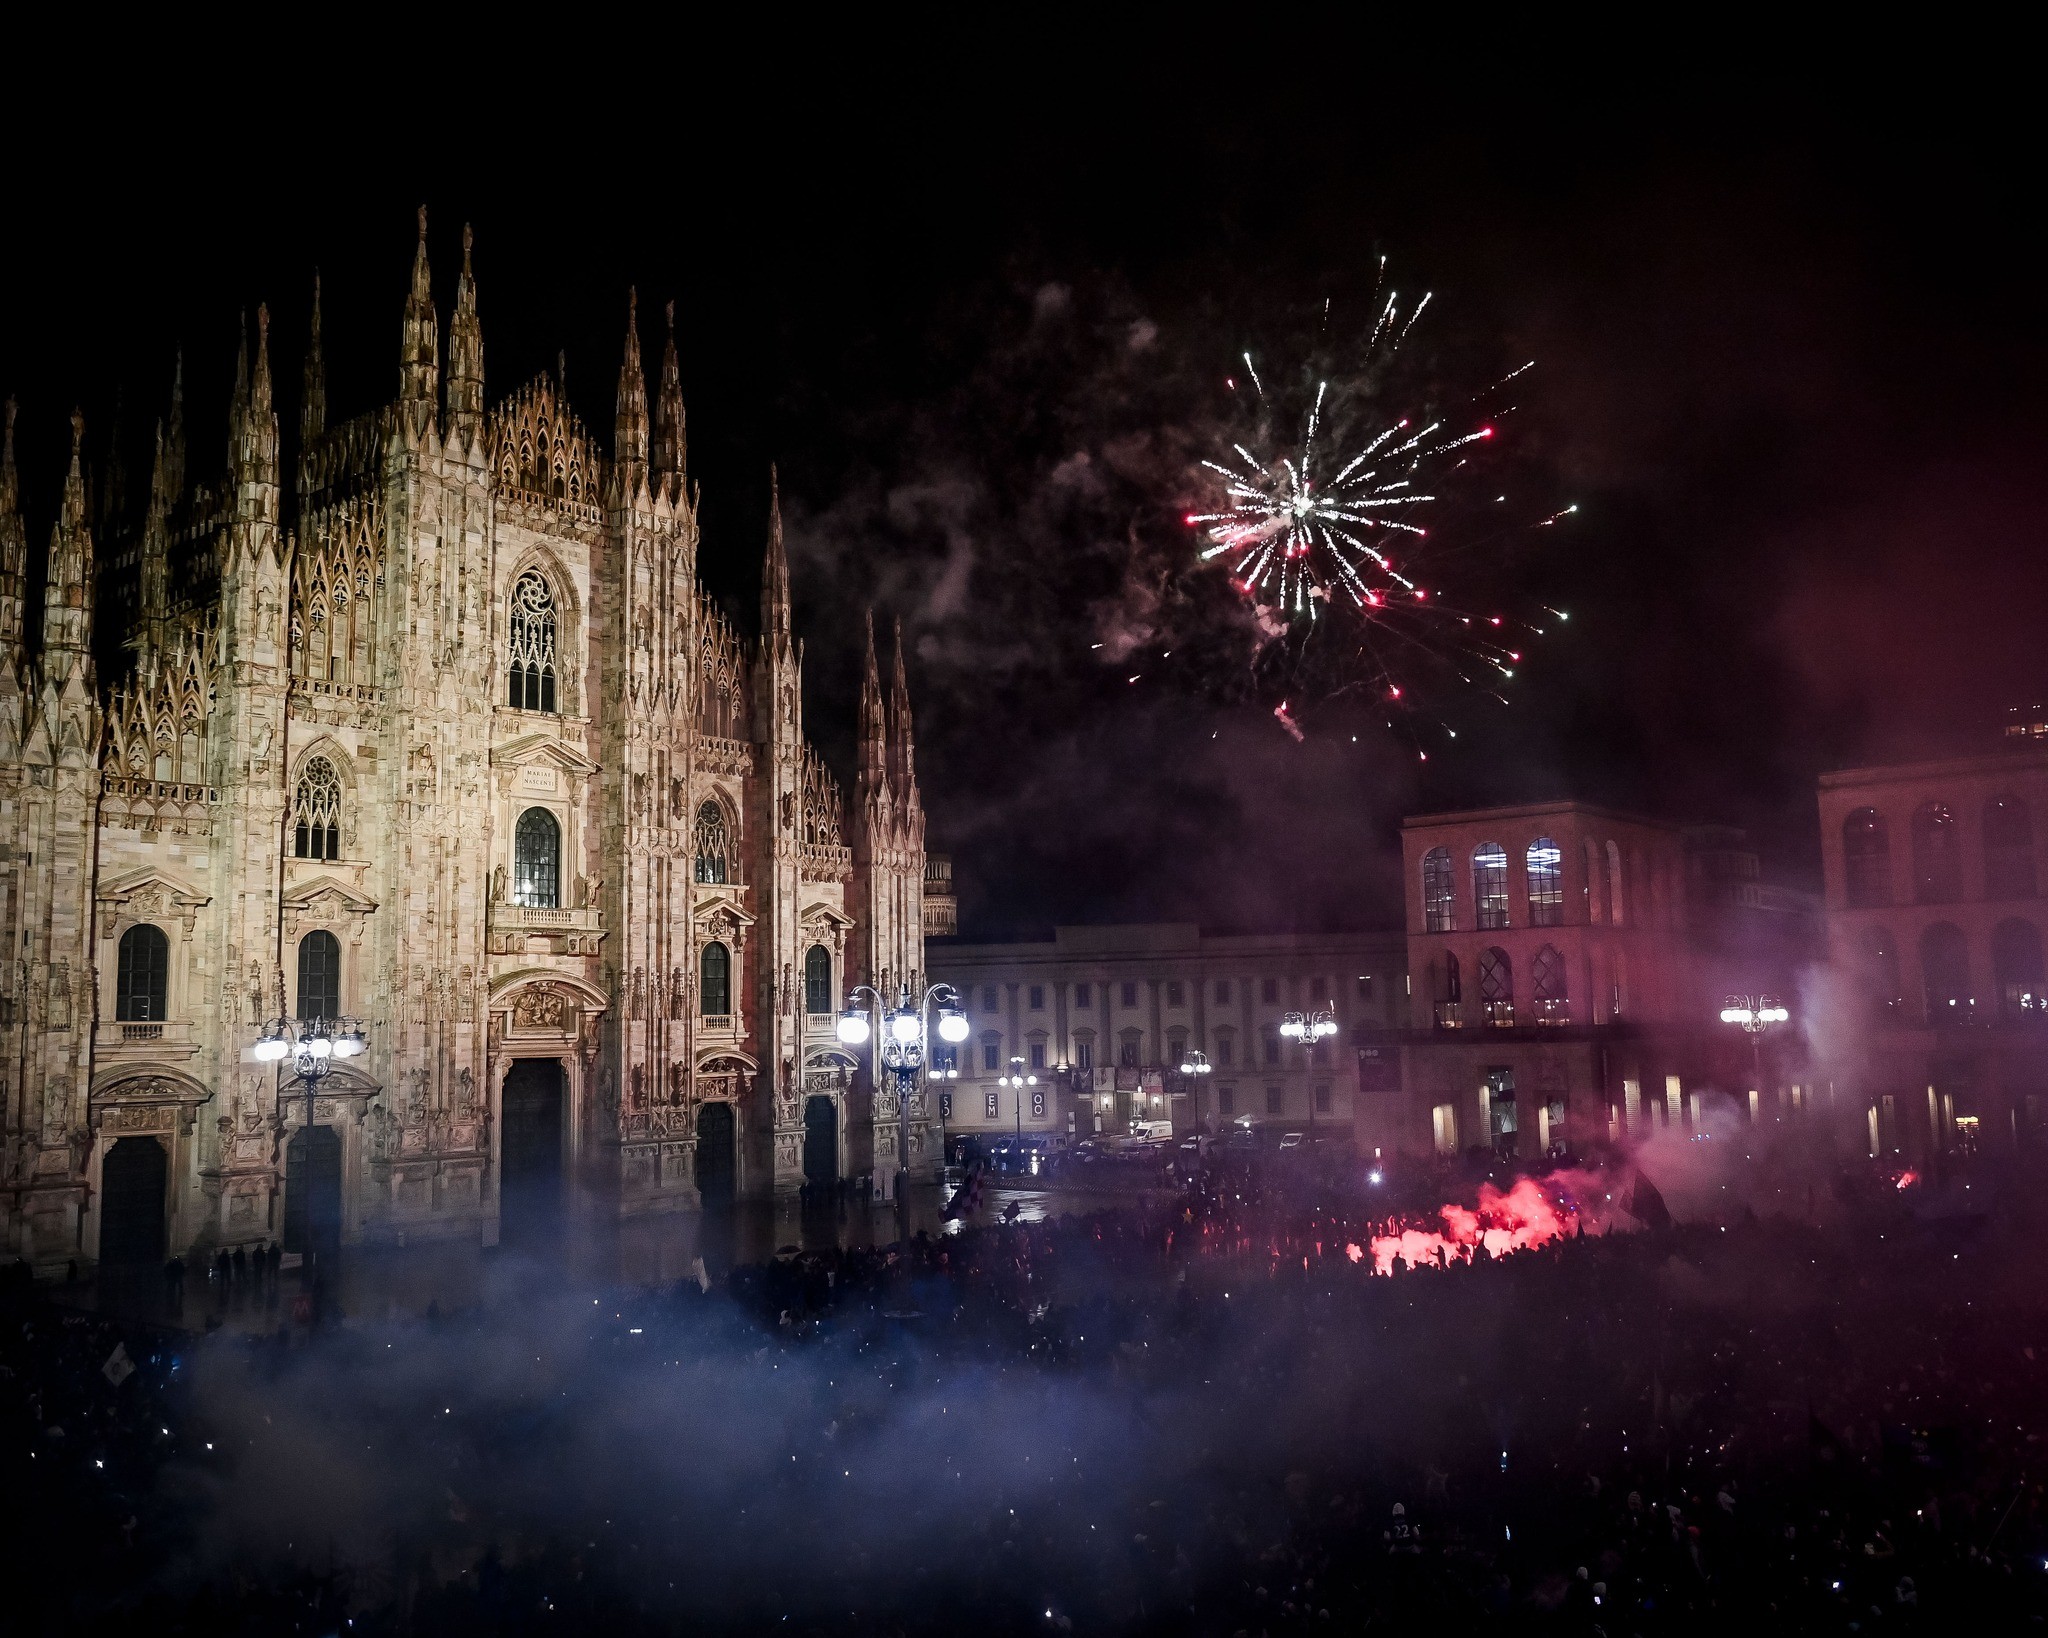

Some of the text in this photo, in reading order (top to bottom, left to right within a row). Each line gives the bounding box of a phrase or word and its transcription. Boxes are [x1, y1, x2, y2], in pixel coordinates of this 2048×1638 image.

[527, 770, 551, 778] MARIAE
[524, 778, 554, 786] NASCENTI
[1393, 1524, 1410, 1538] 22
